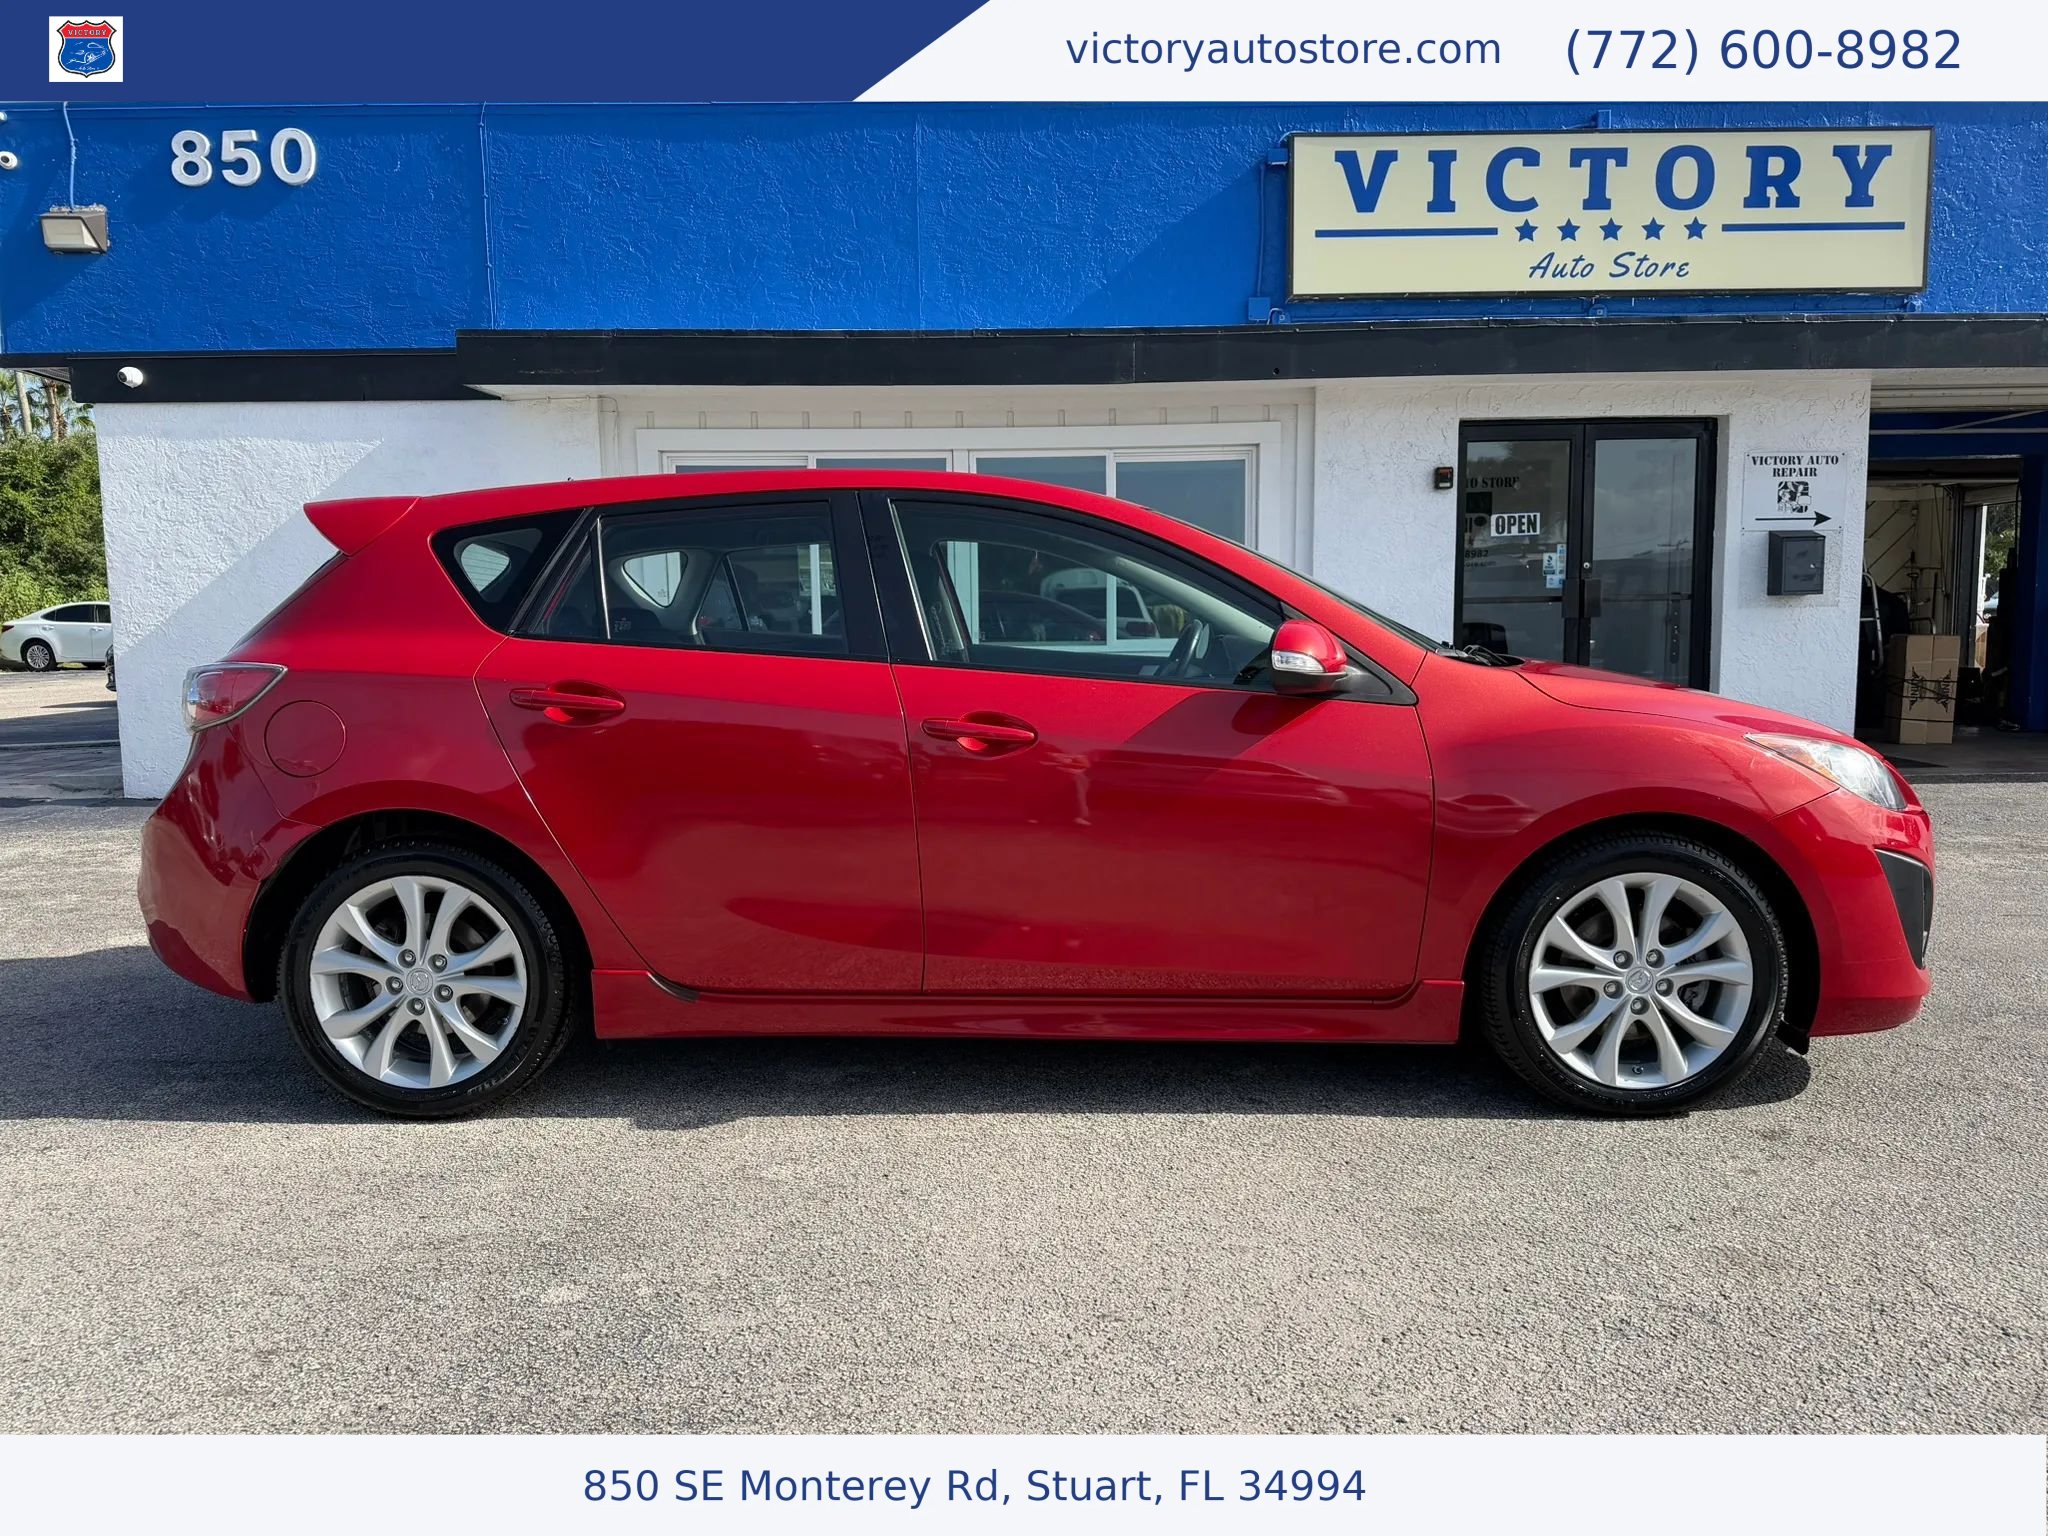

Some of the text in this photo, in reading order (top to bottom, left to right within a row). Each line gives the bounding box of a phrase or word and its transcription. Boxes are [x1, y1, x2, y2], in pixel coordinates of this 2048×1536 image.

[171, 127, 317, 187] 850
[1335, 145, 1893, 213] VICTORY
[1529, 251, 1691, 279] Auto Store
[1752, 455, 1839, 466] VICTORY AUTO
[1772, 467, 1817, 478] REPAIR
[1495, 514, 1537, 535] OPEN
[1464, 549, 1489, 559] 8982
